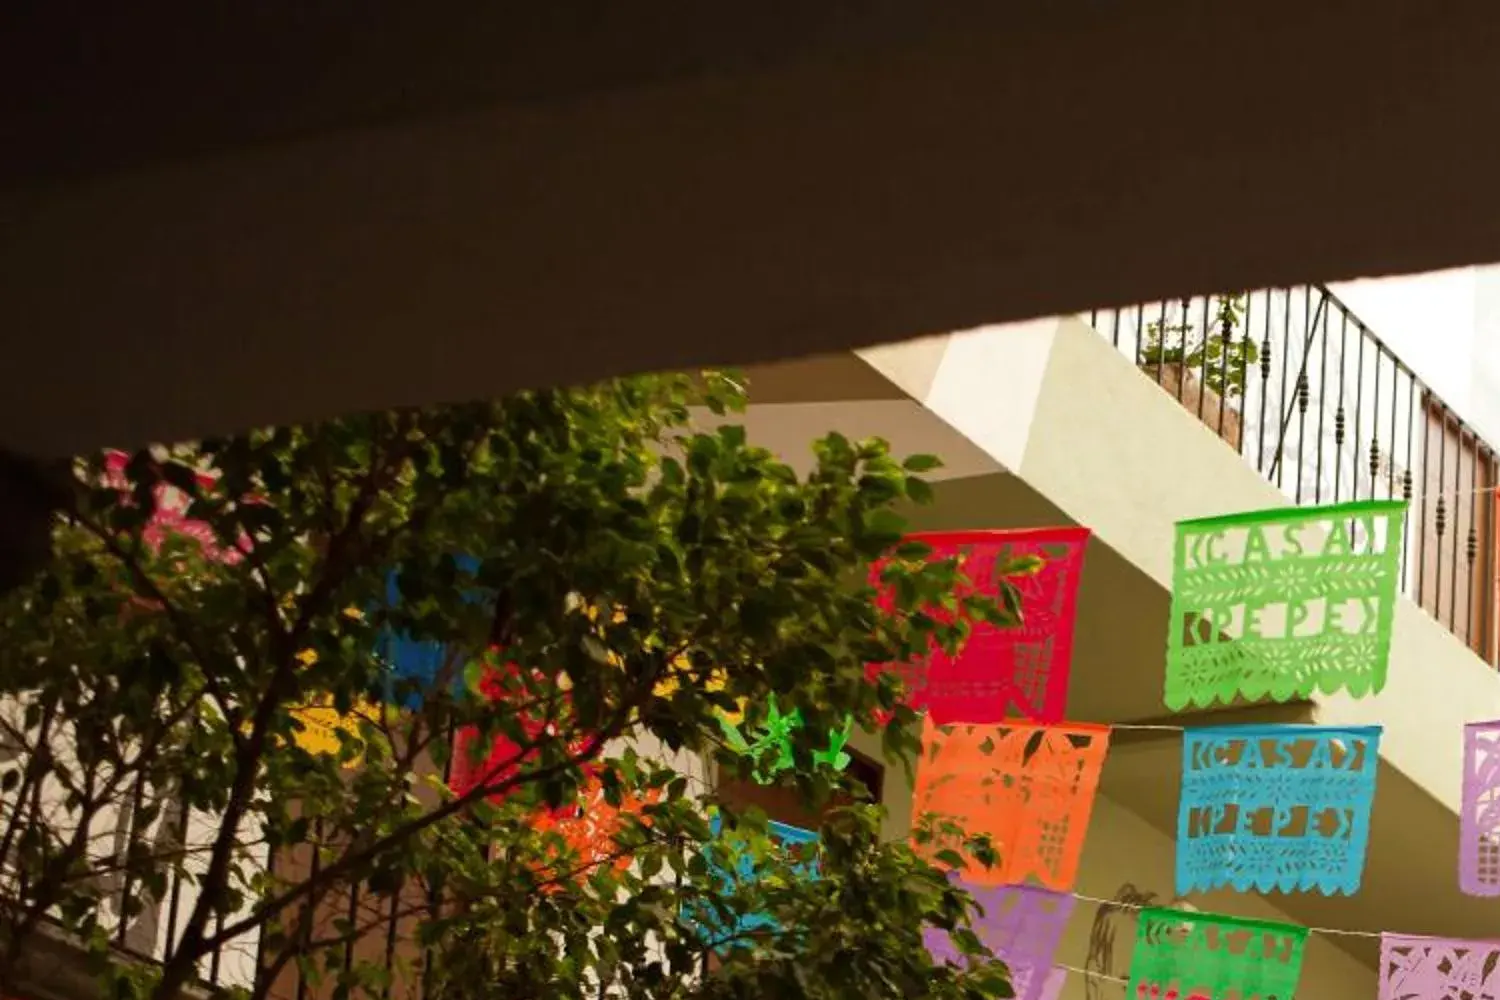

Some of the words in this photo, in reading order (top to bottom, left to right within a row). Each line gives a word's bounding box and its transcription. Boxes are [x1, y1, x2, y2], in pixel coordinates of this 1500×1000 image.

[1206, 518, 1351, 566] CASA
[1212, 597, 1345, 642] PEPE
[1209, 738, 1333, 769] CASA
[1210, 805, 1321, 837] PEPE
